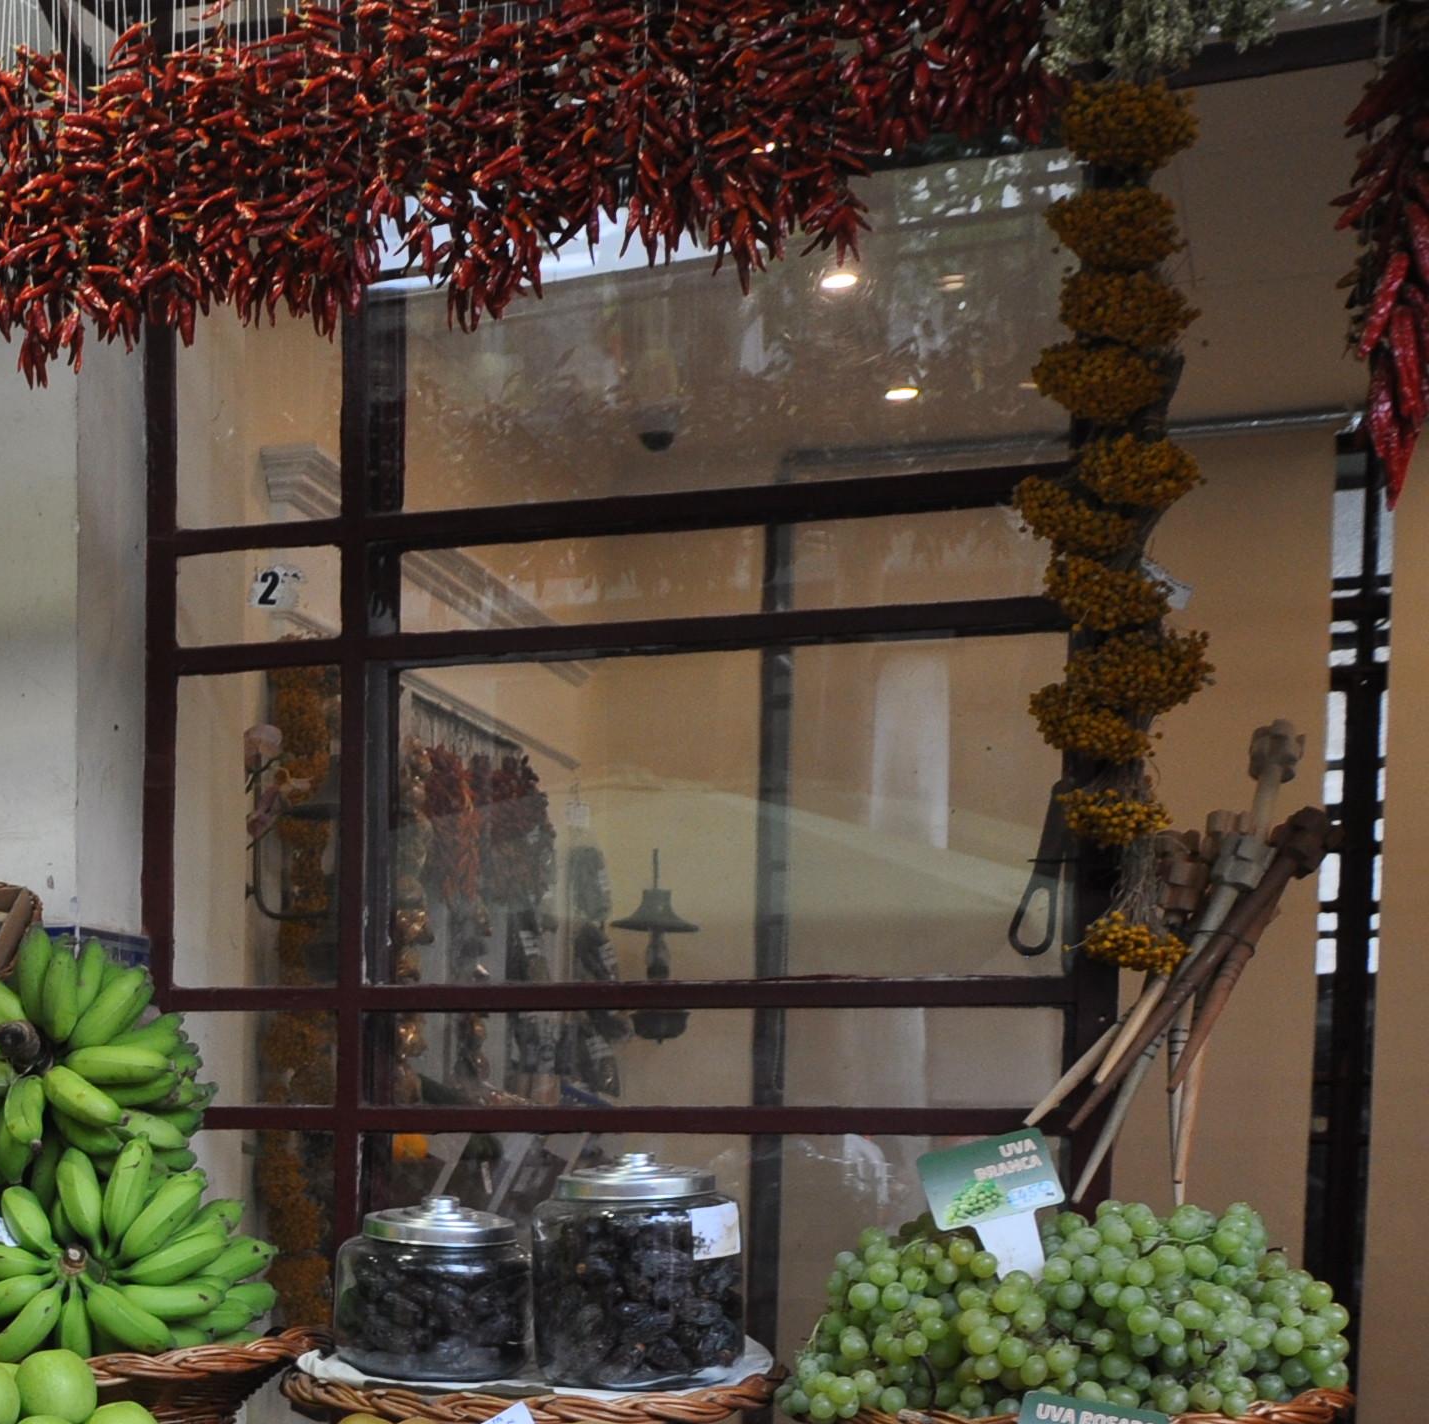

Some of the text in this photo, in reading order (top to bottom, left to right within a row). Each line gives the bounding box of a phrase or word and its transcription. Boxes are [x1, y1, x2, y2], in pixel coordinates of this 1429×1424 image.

[998, 1138, 1037, 1158] UVA
[973, 1154, 1043, 1182] BRANCA
[1035, 1403, 1076, 1424] UVA
